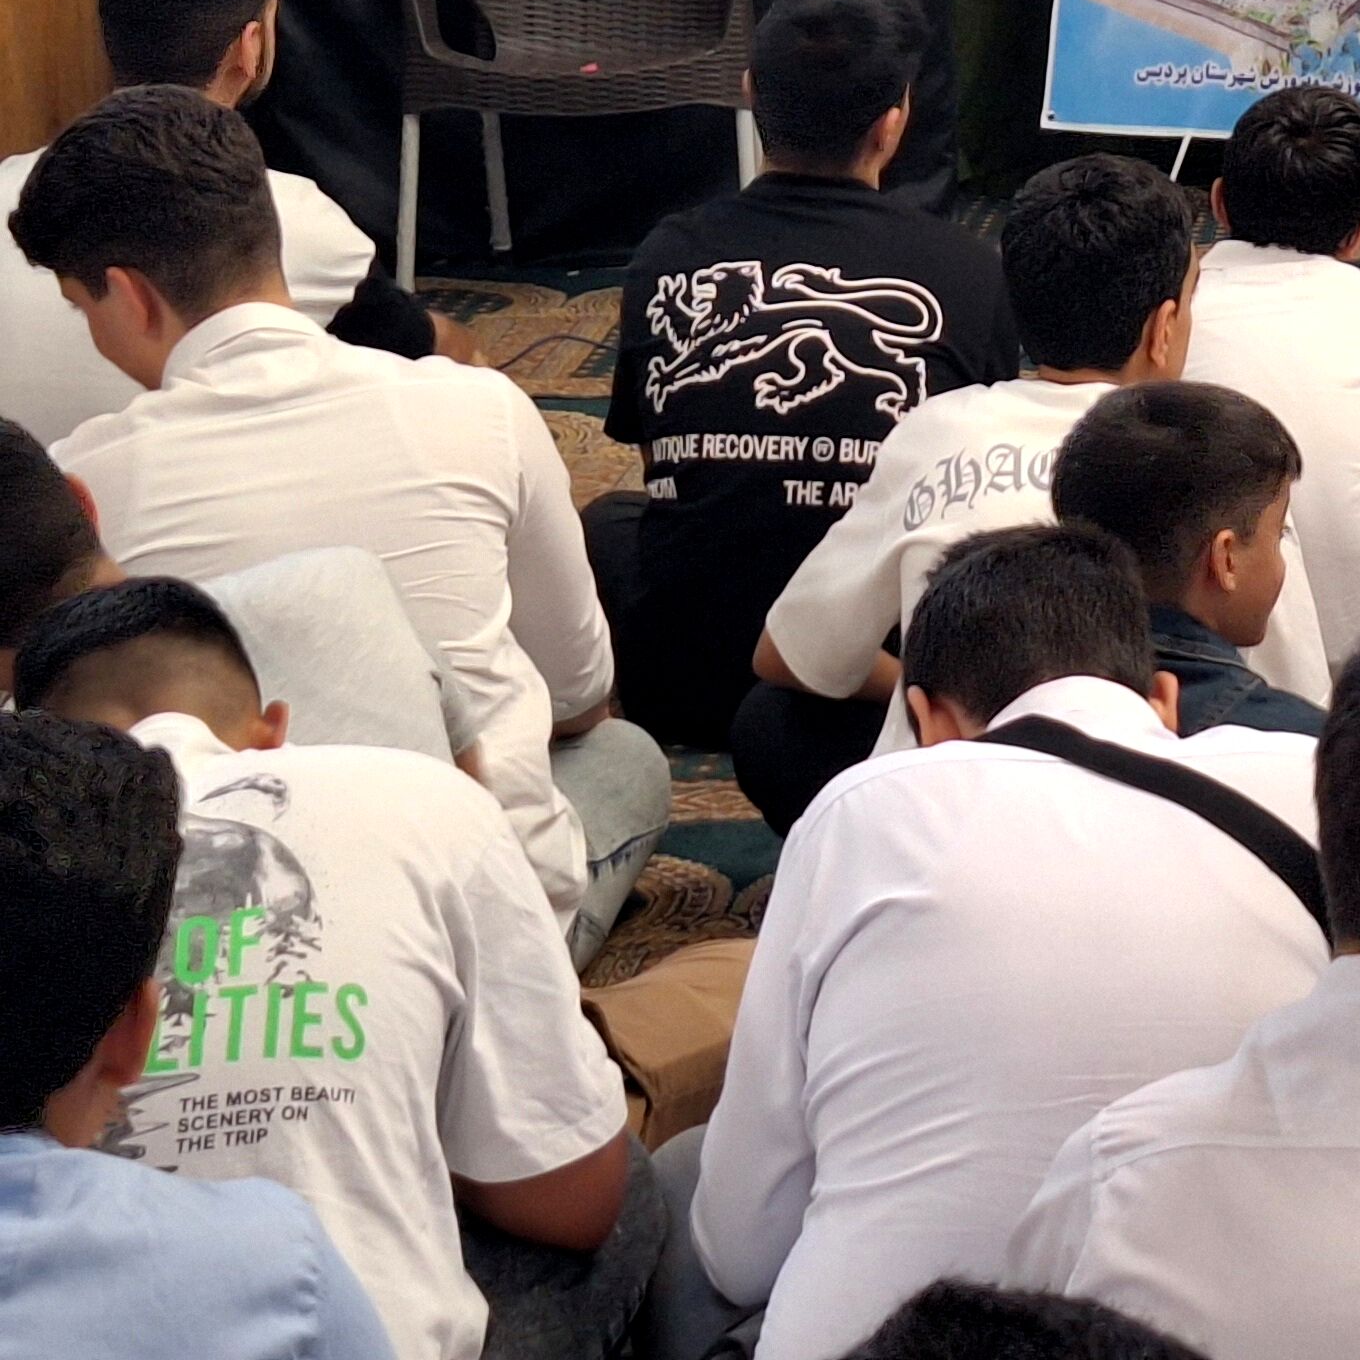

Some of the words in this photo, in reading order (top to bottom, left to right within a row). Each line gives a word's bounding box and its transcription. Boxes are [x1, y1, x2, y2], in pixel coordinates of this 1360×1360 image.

[1136, 63, 1189, 85] پردیس
[1191, 63, 1256, 88] شهرستان
[702, 433, 810, 462] RECOVERY
[783, 479, 824, 506] THE
[173, 905, 266, 986] OF
[179, 1093, 219, 1114] THE
[226, 1086, 285, 1107] MOST
[177, 1107, 275, 1134] SCENERY
[280, 1105, 309, 1123] ON
[176, 1133, 216, 1155] THE
[223, 1127, 269, 1148] TRIP
